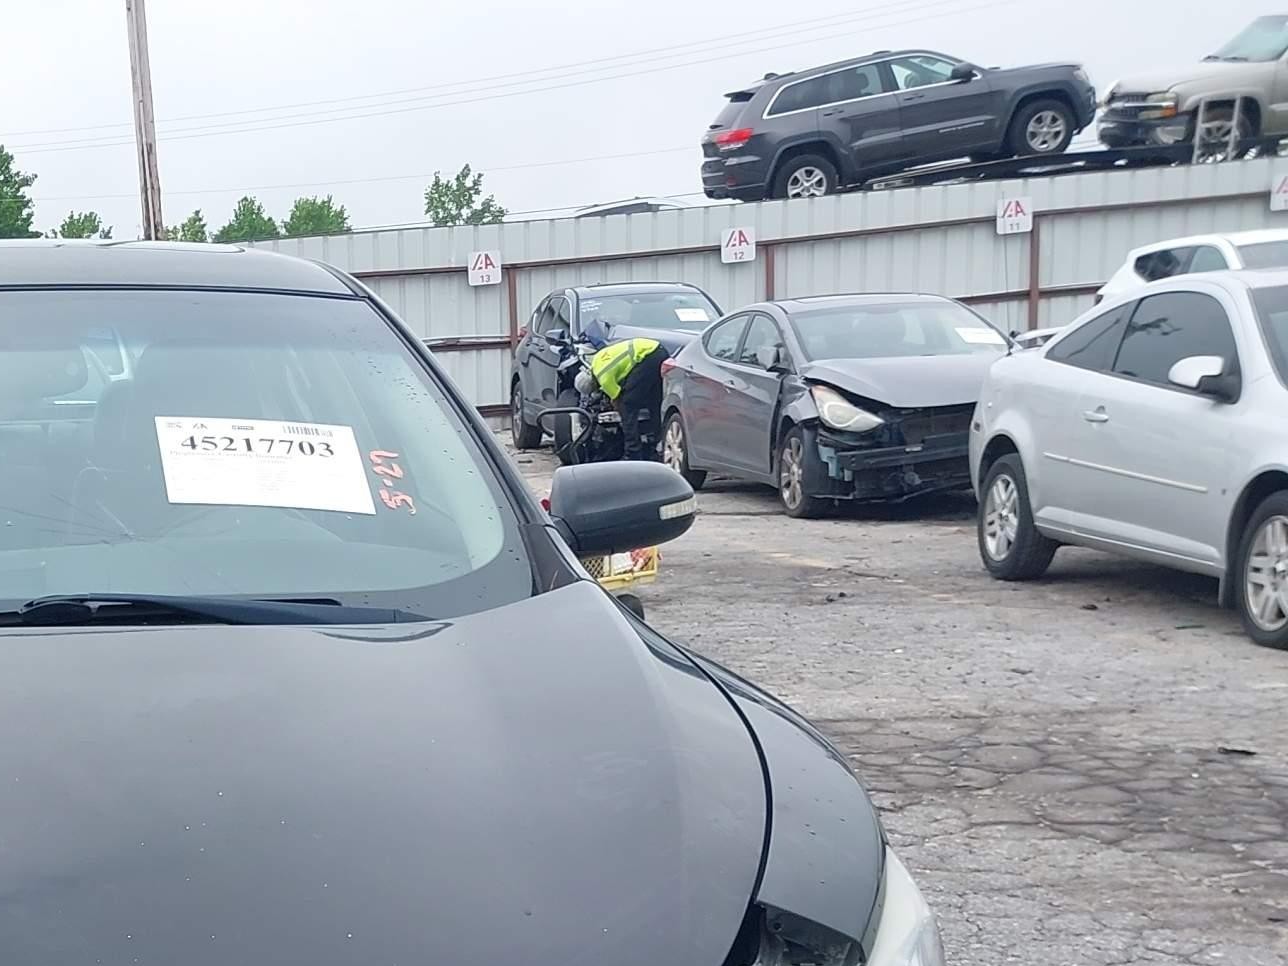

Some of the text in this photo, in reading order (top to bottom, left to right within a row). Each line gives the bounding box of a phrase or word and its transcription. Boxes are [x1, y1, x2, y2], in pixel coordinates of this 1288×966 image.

[1009, 223, 1020, 231] 11
[734, 251, 745, 261] 12
[479, 274, 491, 283] 13
[181, 435, 335, 457] 45217703
